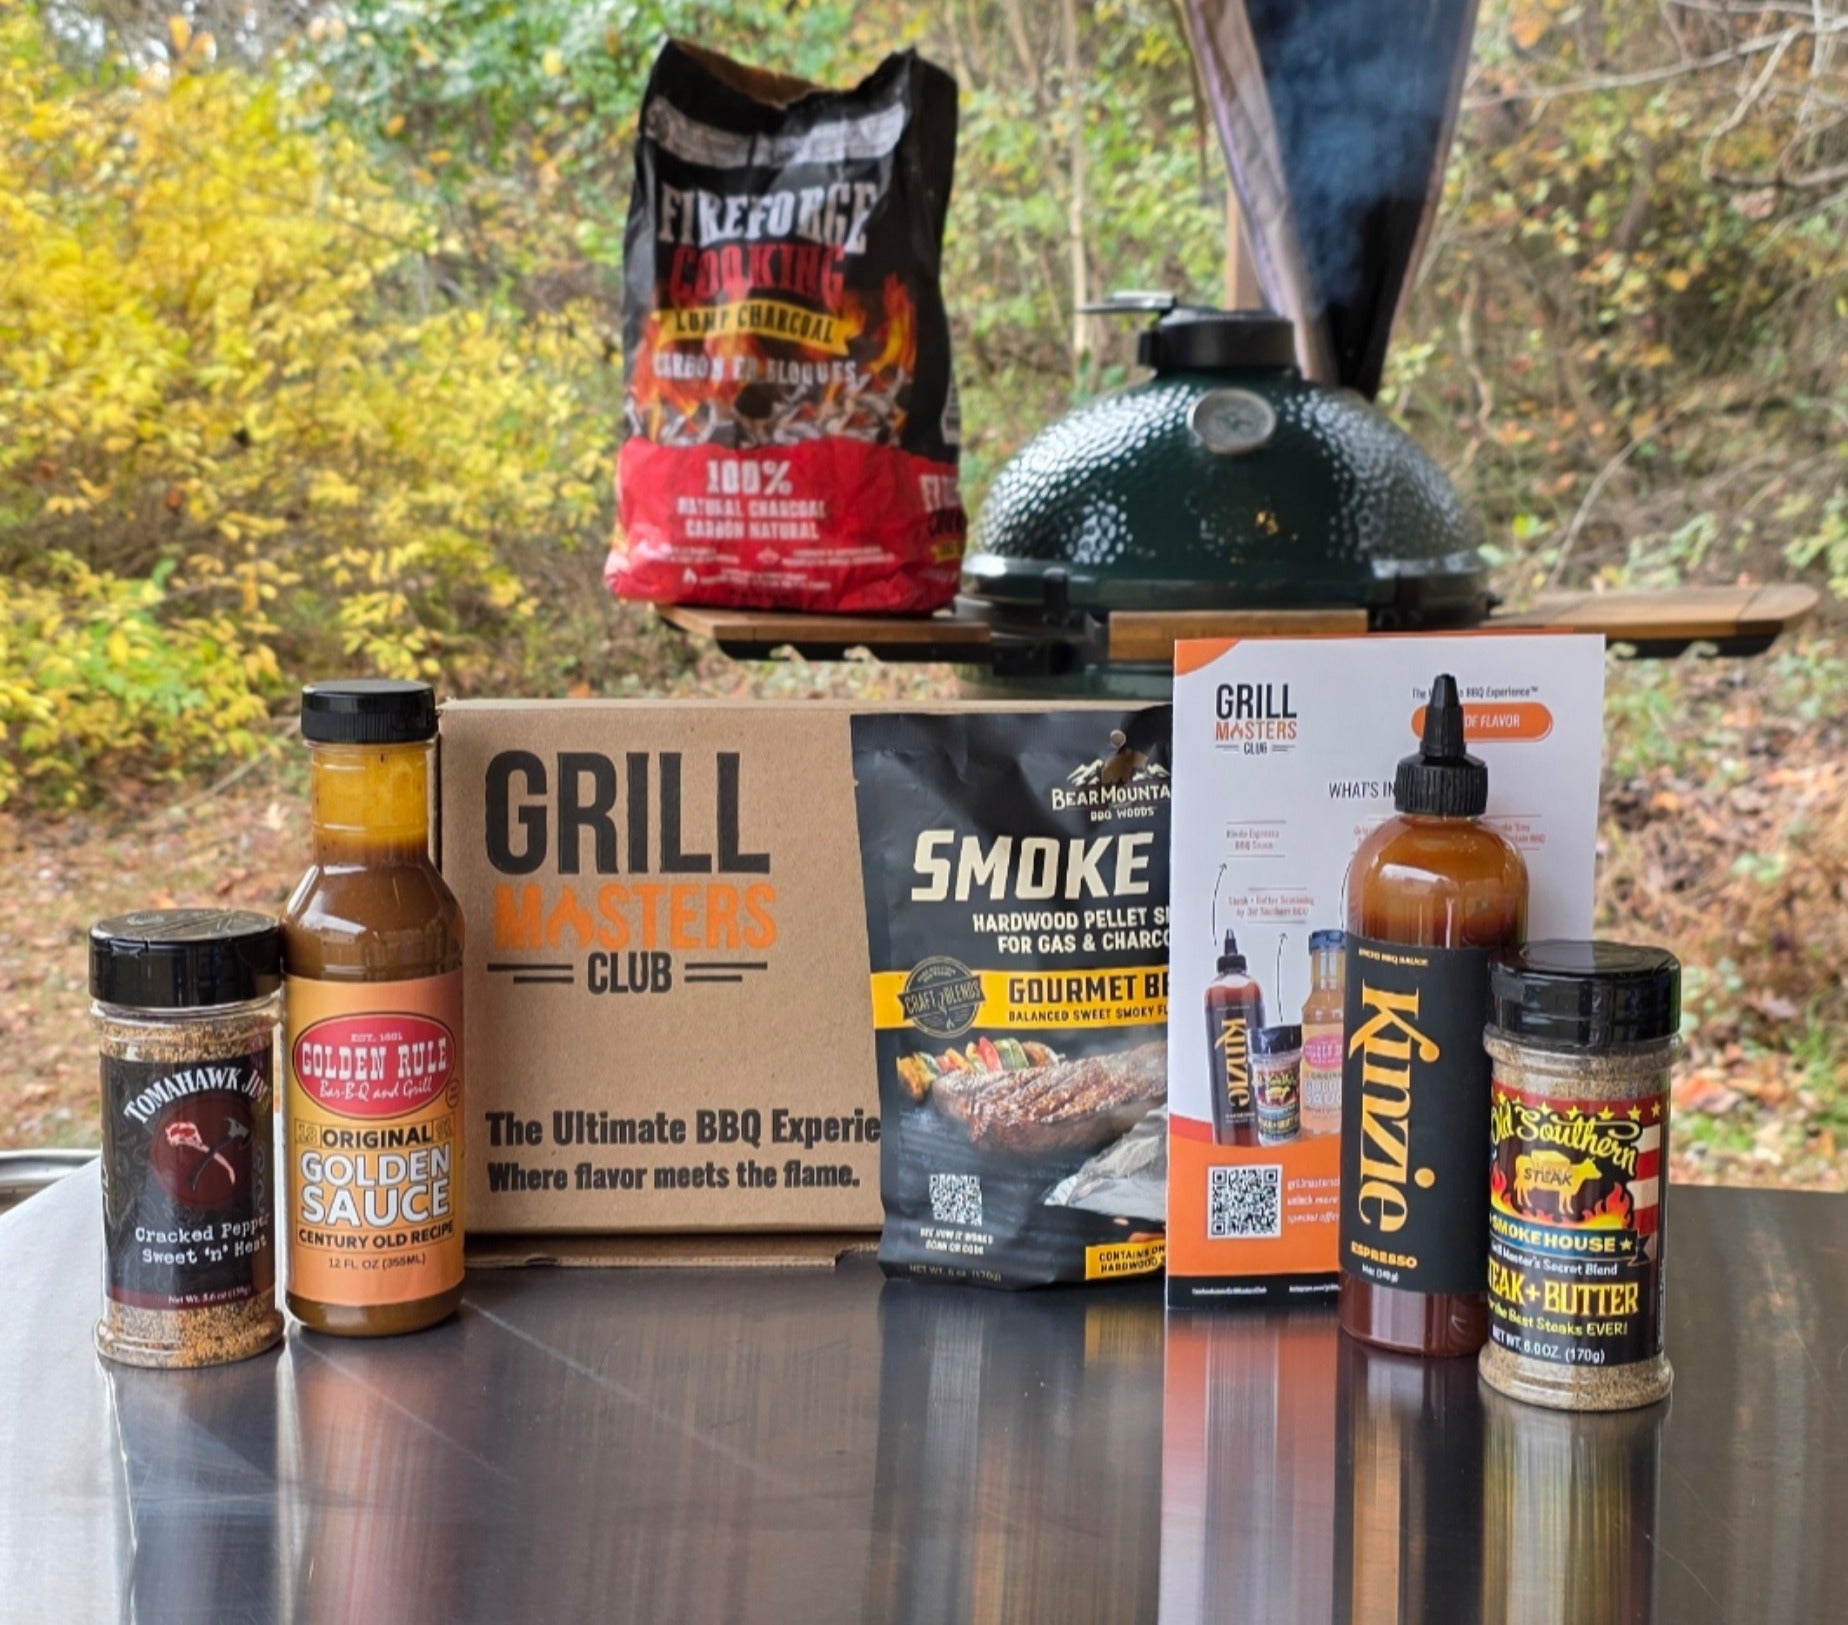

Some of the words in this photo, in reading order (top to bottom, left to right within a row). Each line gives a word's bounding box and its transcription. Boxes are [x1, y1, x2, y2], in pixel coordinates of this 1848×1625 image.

[658, 181, 878, 254] FIREFORGE
[669, 244, 845, 309] COOKING
[675, 309, 728, 332] LUMP
[737, 305, 834, 342] CHARCOAL
[762, 360, 858, 386] BLOQUES
[706, 460, 793, 495] 100%
[677, 497, 744, 517] NATURAL
[748, 499, 826, 519] CHARCOAL
[750, 521, 819, 540] NATURAL
[1216, 683, 1297, 719] GRILL
[1412, 688, 1426, 699] The
[1466, 687, 1484, 699] BBQ
[1215, 720, 1297, 740] MASTERS
[1480, 714, 1520, 728] FLAVOR
[1243, 741, 1267, 755] CLUB
[1329, 780, 1379, 798] WHAT'S
[485, 749, 770, 875] GRILL
[1117, 806, 1155, 819] WOODS
[911, 829, 1154, 902] SMOKE
[493, 883, 778, 950] MASTERS
[972, 913, 1078, 933] HARDWOOD
[1084, 907, 1147, 929] PELLET
[998, 935, 1032, 955] FOR
[1038, 934, 1076, 954] GAS
[1082, 933, 1097, 952] &
[587, 951, 673, 995] CLUB
[905, 990, 937, 1015] CRAFT
[1009, 974, 1137, 1004] GOURMET
[1009, 1008, 1069, 1022] BALANCED
[1073, 1007, 1111, 1021] SWEET
[1116, 1005, 1154, 1020] SMOKY
[302, 1042, 387, 1081] GOLDEN
[398, 1037, 447, 1079] RULE
[123, 1067, 243, 1124] TOMAHAWK
[373, 1081, 400, 1099] and
[403, 1076, 433, 1098] Grill
[1348, 978, 1440, 1233] Kinzie
[323, 1125, 432, 1149] ORIGINAL
[486, 1111, 543, 1147] The
[553, 1110, 687, 1145] Ultimate
[696, 1109, 762, 1149] BBQ
[772, 1108, 881, 1149] Experie
[1515, 1105, 1642, 1177] Southern
[300, 1144, 451, 1187] GOLDEN
[488, 1162, 567, 1192] Where
[574, 1162, 647, 1190] flavor
[653, 1162, 730, 1189] meets
[737, 1162, 777, 1188] the
[784, 1160, 861, 1189] flame.
[1523, 1167, 1573, 1186] STEAK
[301, 1179, 450, 1228] SAUCE
[135, 1224, 214, 1244] Cracked
[299, 1230, 368, 1249] CENTURY
[372, 1232, 407, 1249] OLD
[411, 1220, 454, 1244] RECIPE
[142, 1248, 198, 1265] Sweet
[234, 1235, 267, 1258] Heat
[329, 1258, 340, 1268] 12
[362, 1259, 378, 1269] OZ
[1099, 1247, 1150, 1263] CONTAINS
[1351, 1240, 1418, 1269] ESPRESSO
[1503, 1246, 1541, 1269] Master's
[1543, 1258, 1583, 1275] Secret
[1585, 1263, 1618, 1276] Blend
[1101, 1257, 1158, 1273] HARDWOOD
[1543, 1279, 1639, 1316] BUTTER
[1508, 1307, 1534, 1328] Best
[1536, 1316, 1583, 1335] Steaks
[1586, 1321, 1628, 1337] EVER!
[1492, 1325, 1506, 1342] NET
[1565, 1347, 1606, 1364] (170g)
